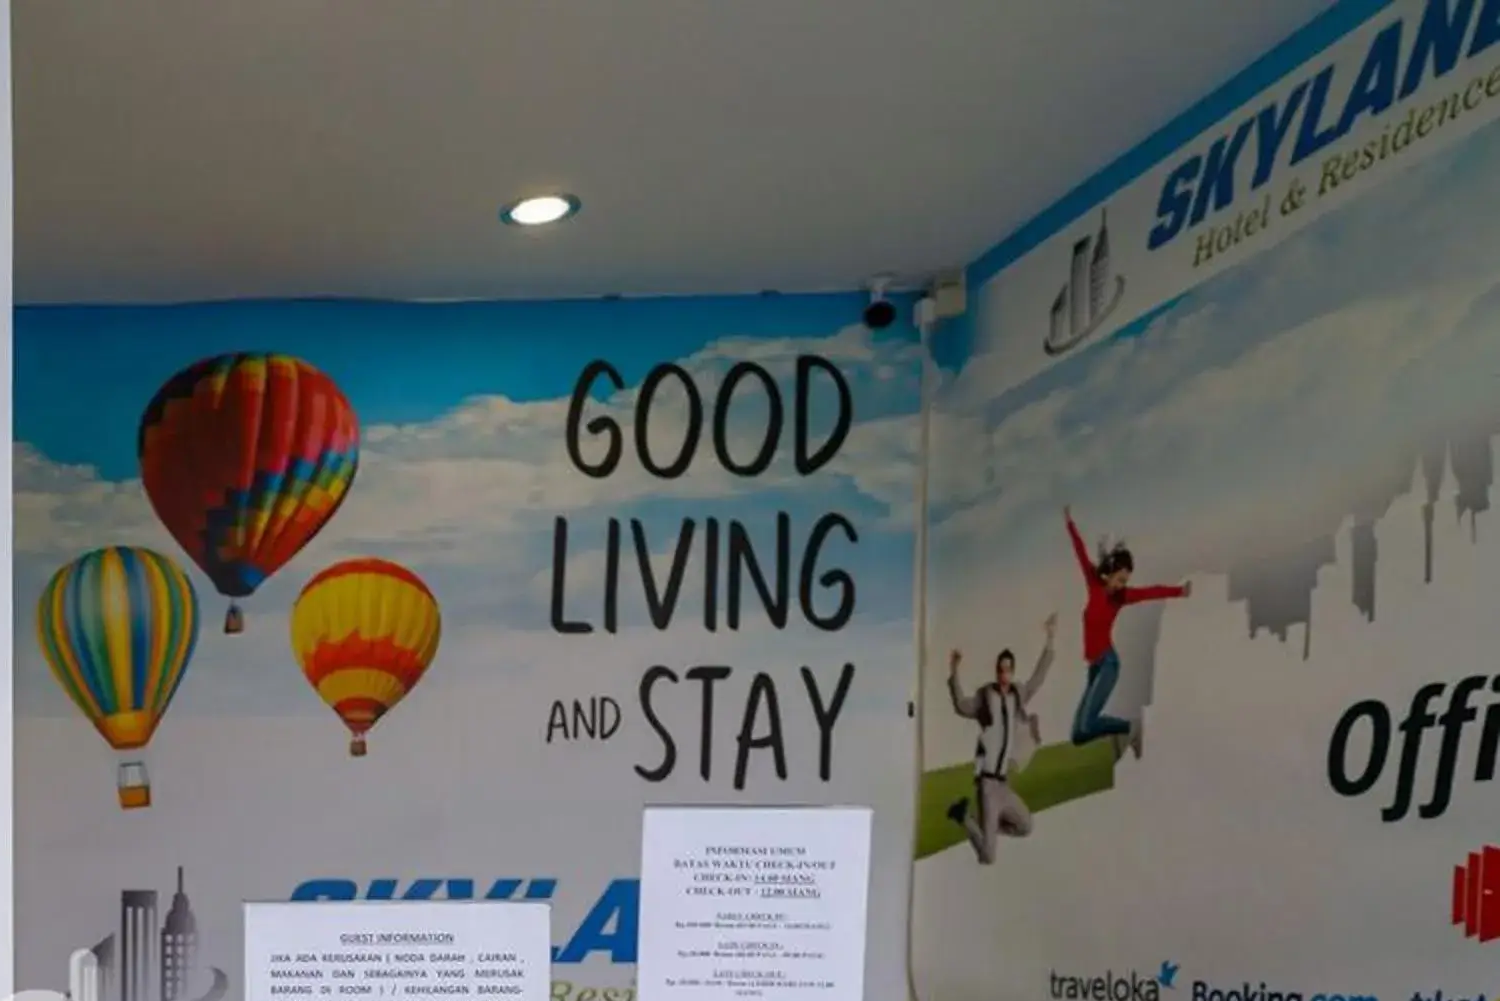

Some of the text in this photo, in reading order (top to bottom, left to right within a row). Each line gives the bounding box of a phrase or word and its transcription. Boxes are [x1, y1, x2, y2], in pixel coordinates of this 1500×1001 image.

[1193, 194, 1271, 268] Hotel
[1280, 177, 1308, 216] &
[566, 355, 853, 479] GOOD
[550, 511, 858, 634] LIVING
[546, 663, 855, 790] AND STAY
[270, 969, 323, 979] MAKANAN
[332, 969, 355, 979] DAN
[436, 969, 465, 979] YANG
[340, 933, 454, 944] GUEST INFORMATION
[270, 985, 313, 996] BARANG
[319, 985, 332, 996] DI
[338, 985, 373, 996] ROOM
